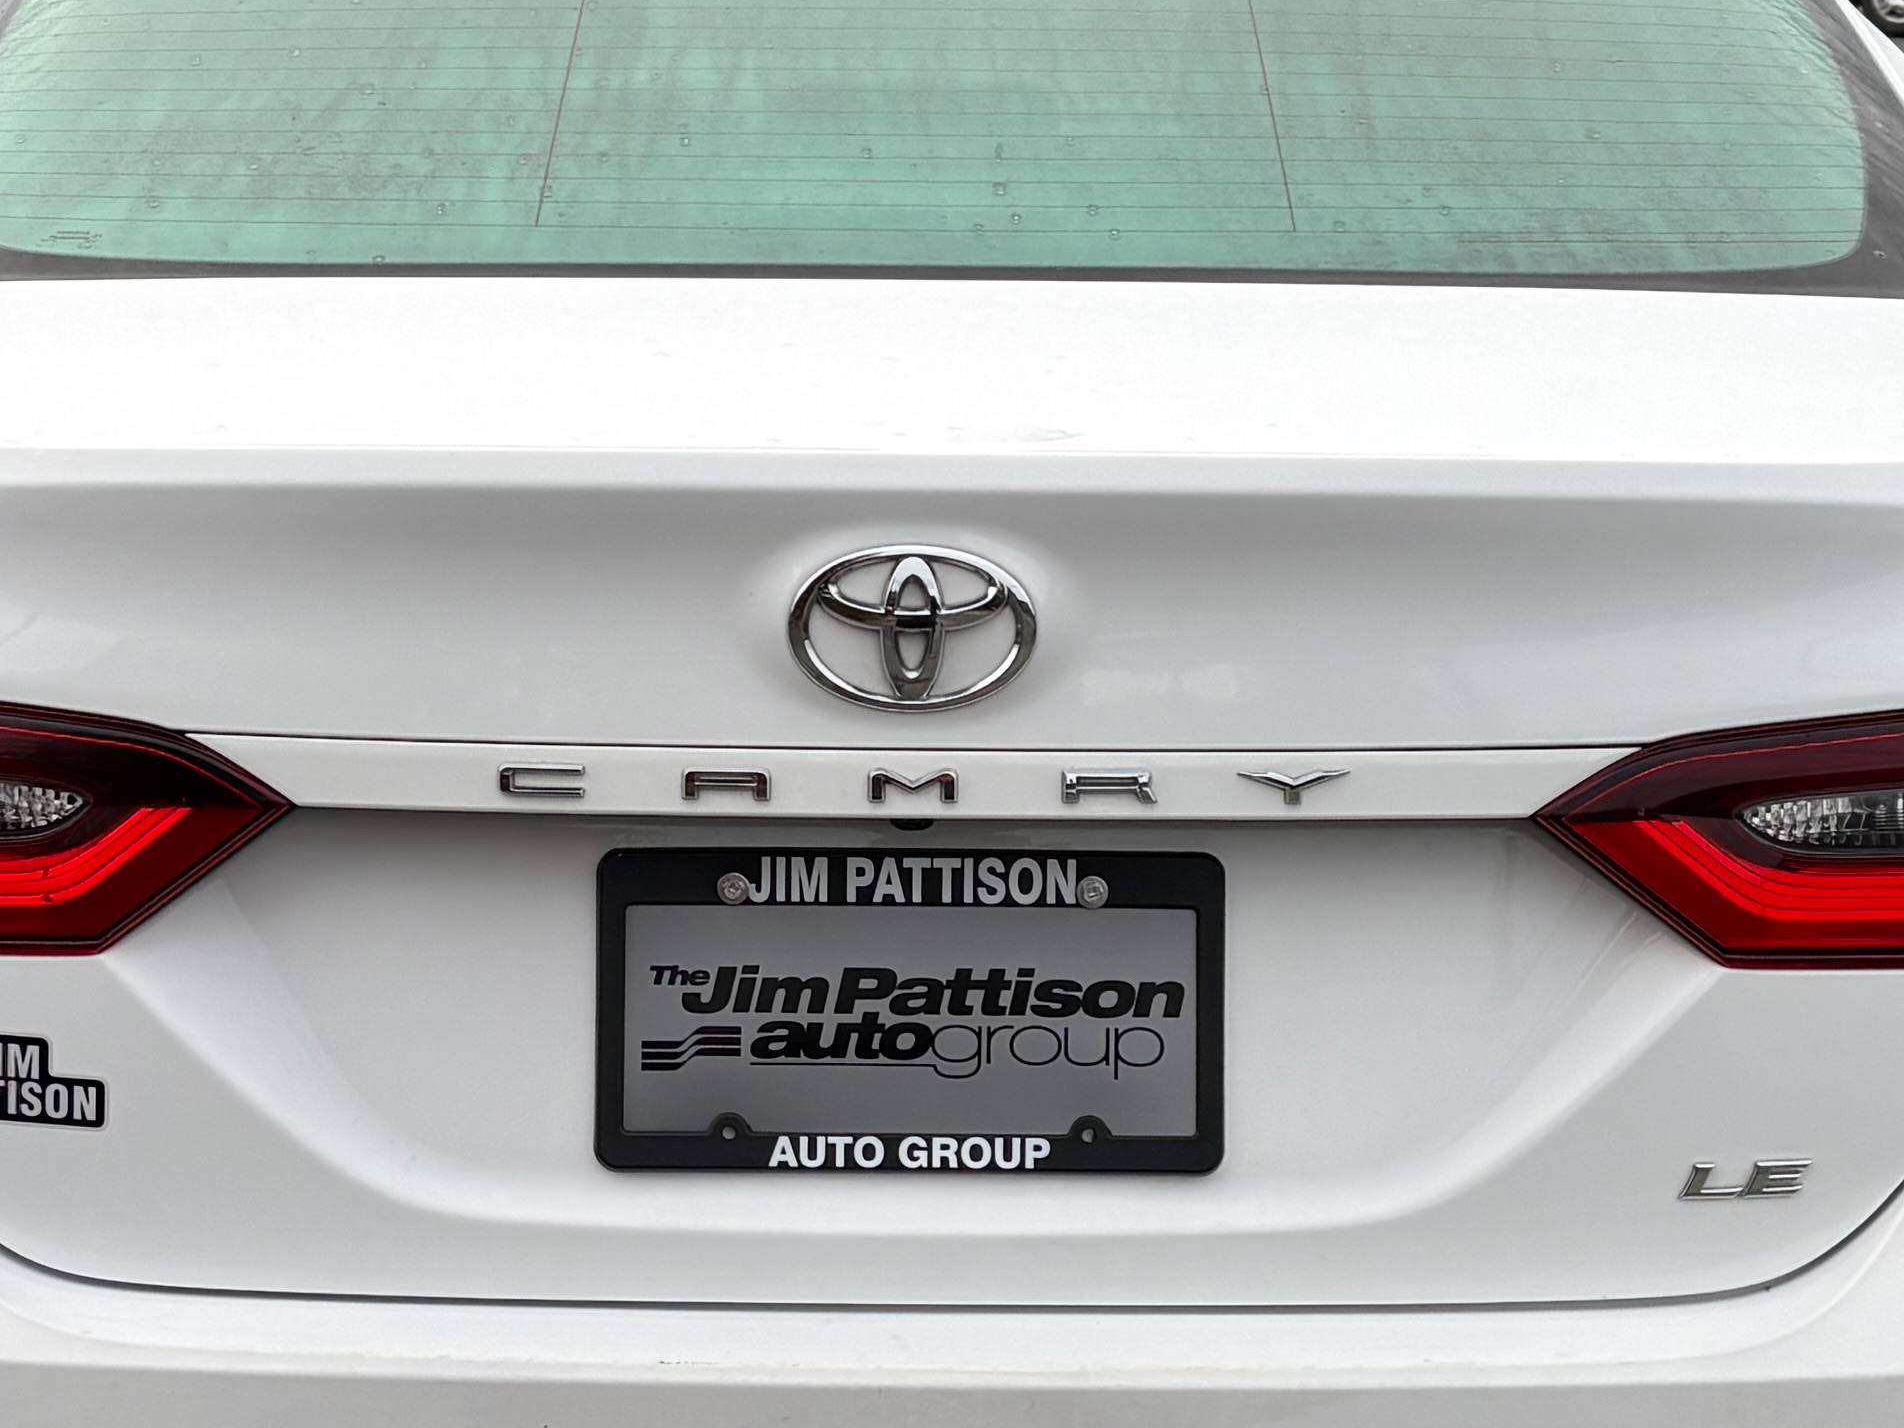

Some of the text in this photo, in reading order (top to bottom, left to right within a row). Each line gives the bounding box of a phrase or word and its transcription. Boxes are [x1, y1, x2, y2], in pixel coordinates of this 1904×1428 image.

[496, 763, 1353, 805] CAMRY
[748, 856, 1078, 905] JIM PATTISON
[649, 964, 711, 986] The
[768, 1135, 1051, 1170] AUTO GROUP
[1678, 1159, 1814, 1200] LE
